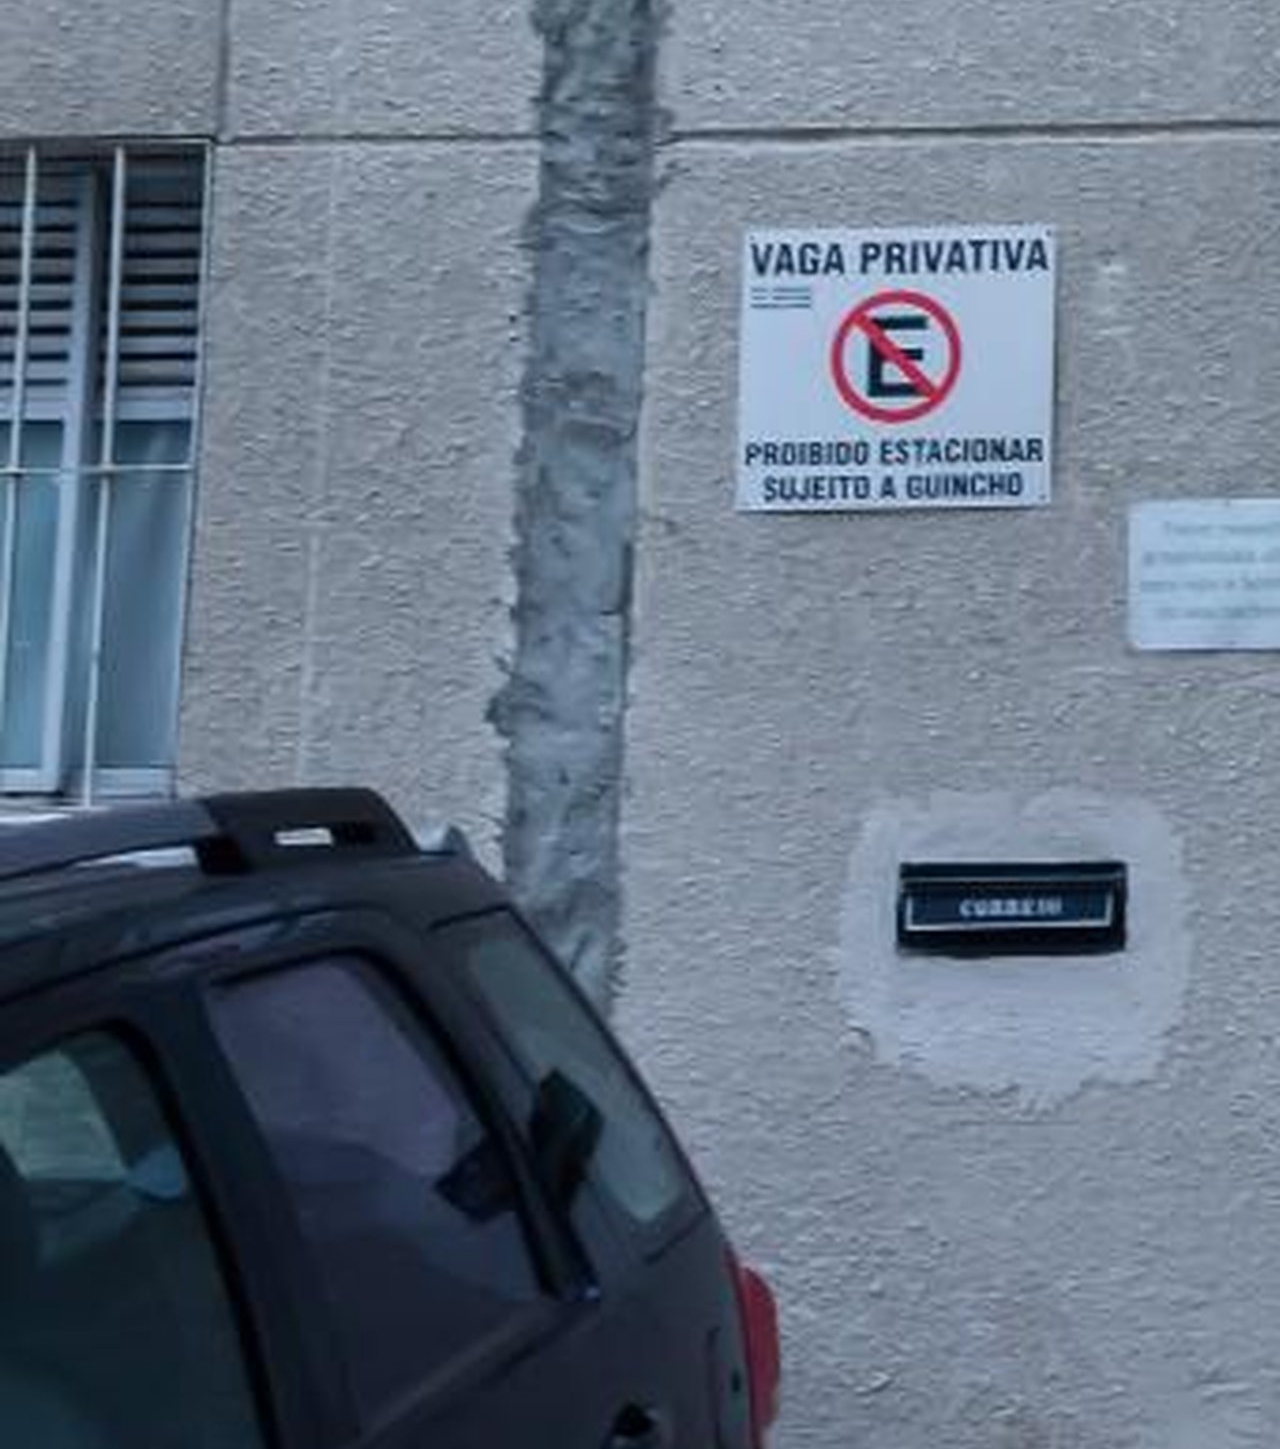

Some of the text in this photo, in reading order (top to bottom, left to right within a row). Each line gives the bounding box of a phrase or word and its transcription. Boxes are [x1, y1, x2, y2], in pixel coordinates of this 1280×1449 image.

[751, 240, 1048, 275] VAGA PRIVATIVA
[867, 316, 929, 397] E
[746, 438, 1043, 466] PROIBIDO ESTACIONAR
[764, 473, 1024, 501] SUJEITO A GUINCHO
